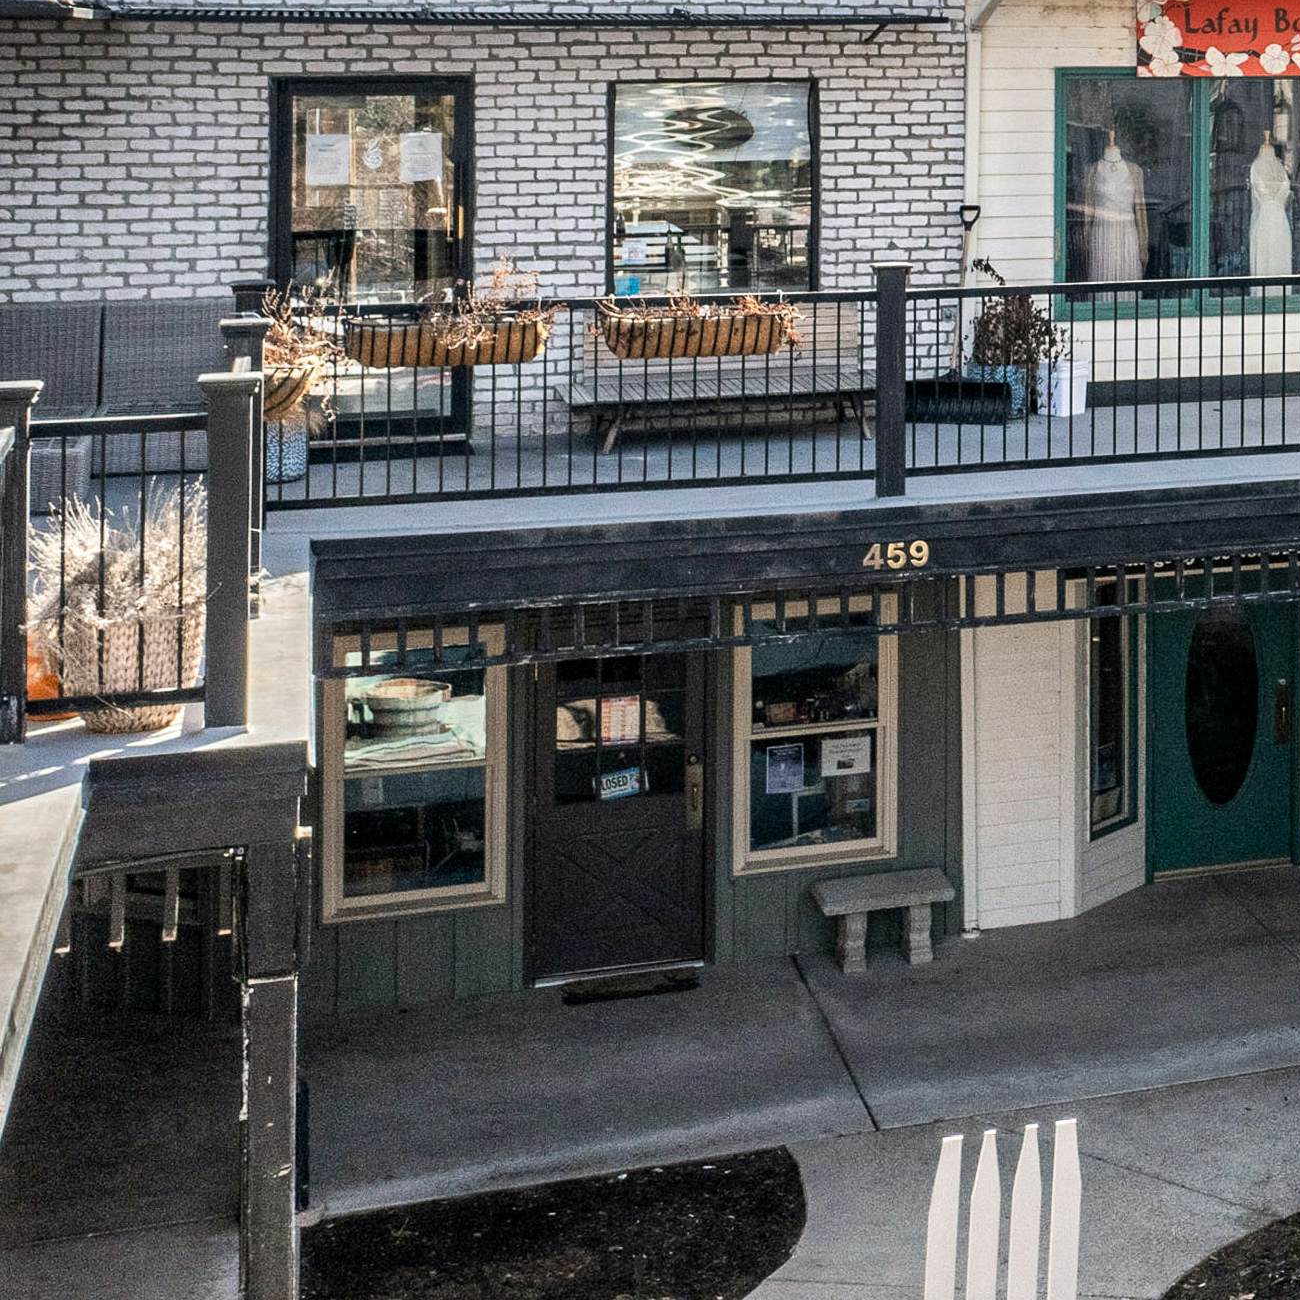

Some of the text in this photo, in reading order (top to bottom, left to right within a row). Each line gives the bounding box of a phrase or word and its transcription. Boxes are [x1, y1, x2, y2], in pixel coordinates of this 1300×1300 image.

[1182, 6, 1260, 39] Lafay
[862, 539, 930, 571] 459
[601, 774, 629, 792] LOSED
